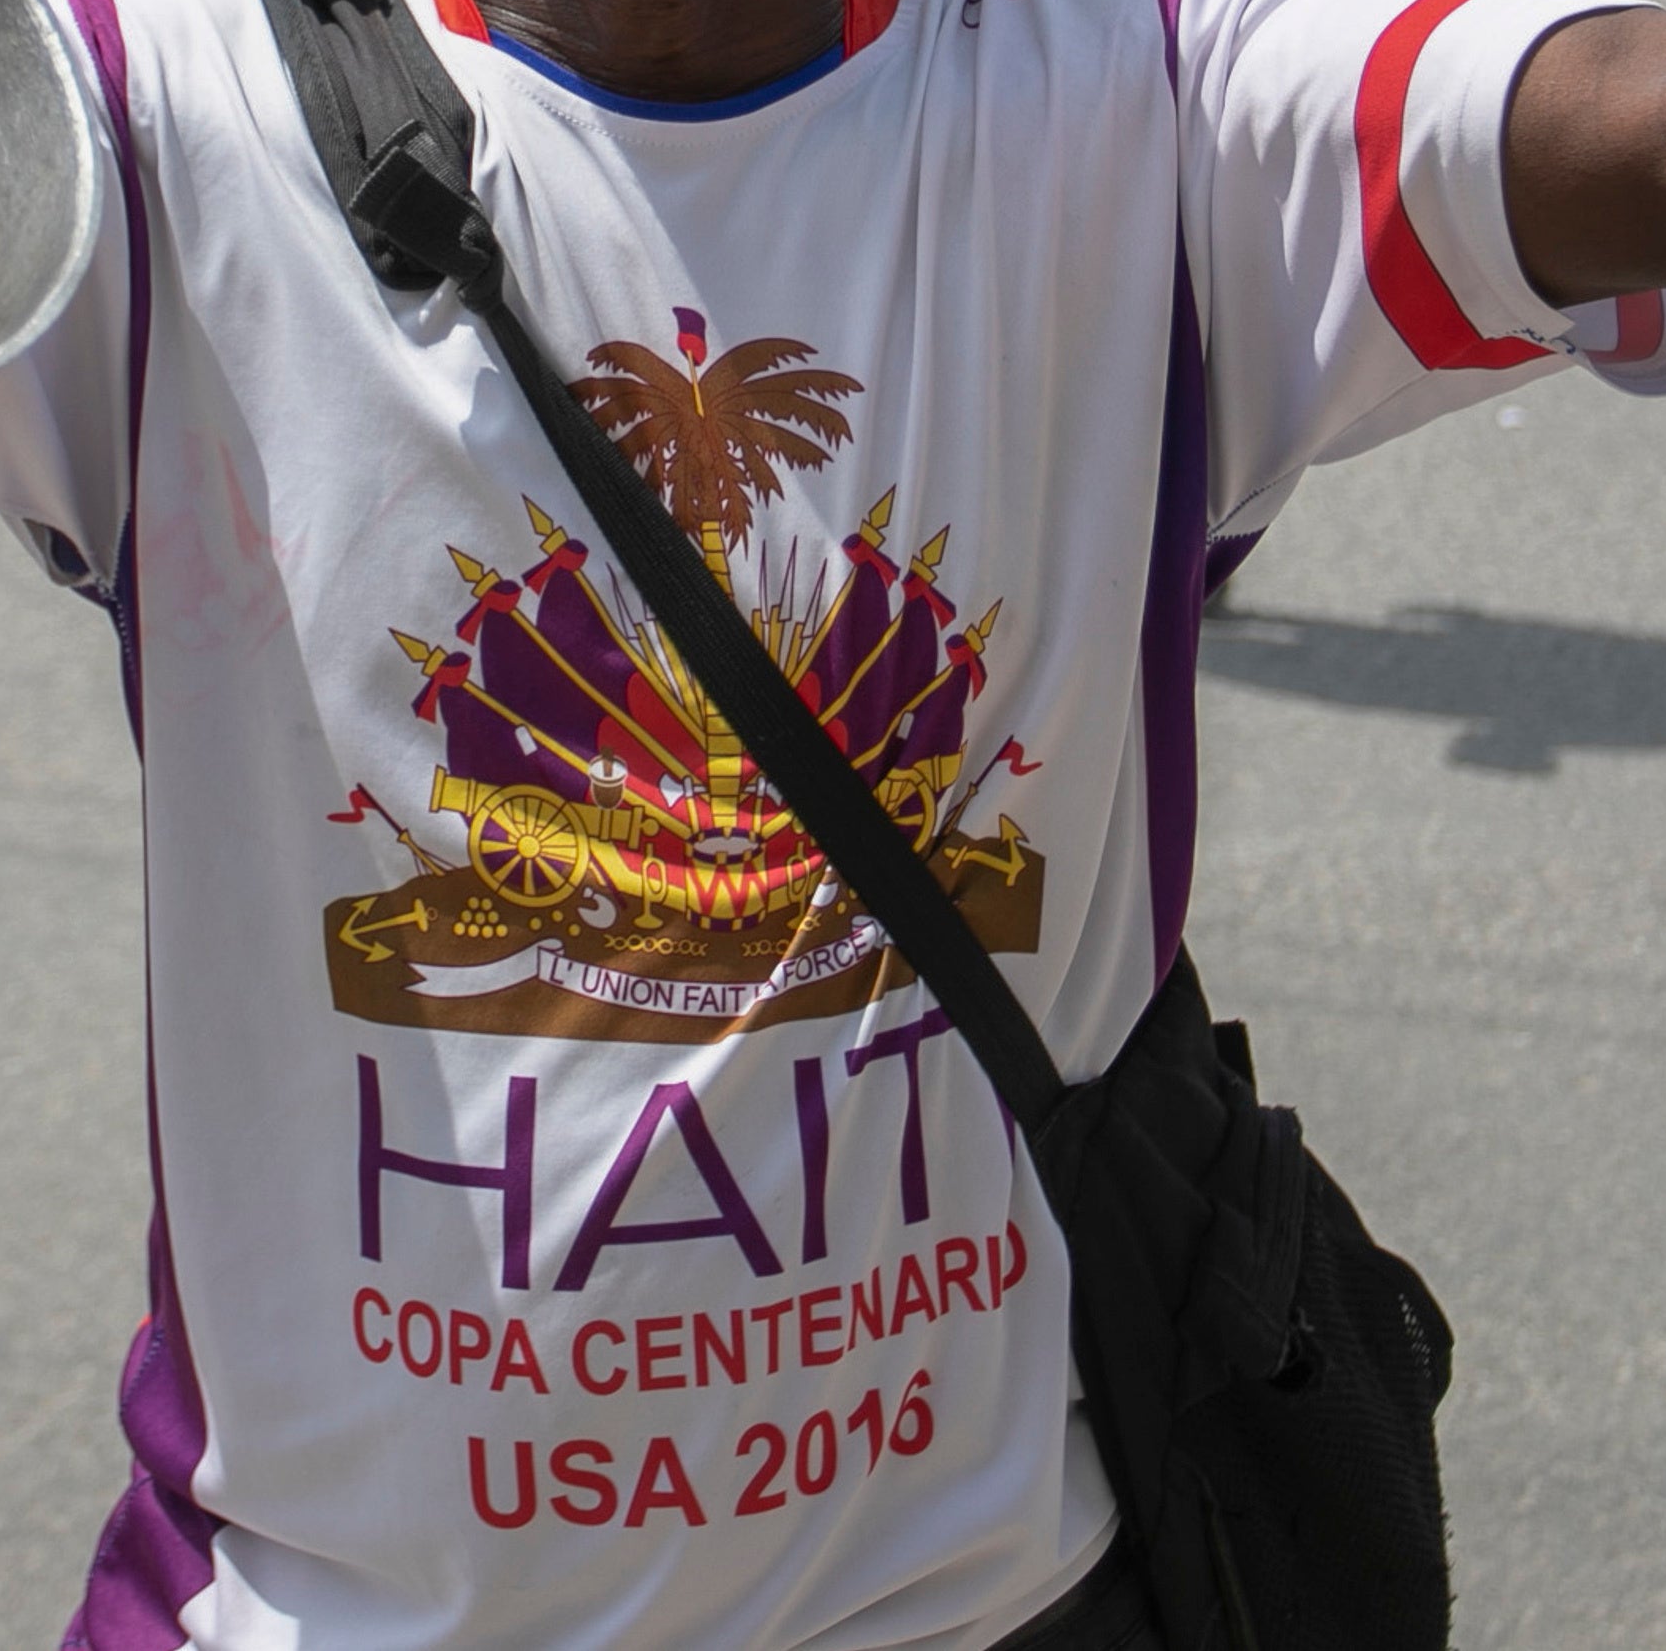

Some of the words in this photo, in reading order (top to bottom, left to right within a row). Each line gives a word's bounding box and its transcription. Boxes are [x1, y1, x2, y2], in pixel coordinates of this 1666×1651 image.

[580, 966, 674, 1009] UNION
[683, 986, 746, 1013] FAIT
[782, 935, 869, 986] FORCE
[356, 1006, 1016, 1291] HAIT
[353, 1287, 550, 1395] COPA
[467, 1435, 708, 1530] USA
[733, 1368, 935, 1517] 2016
